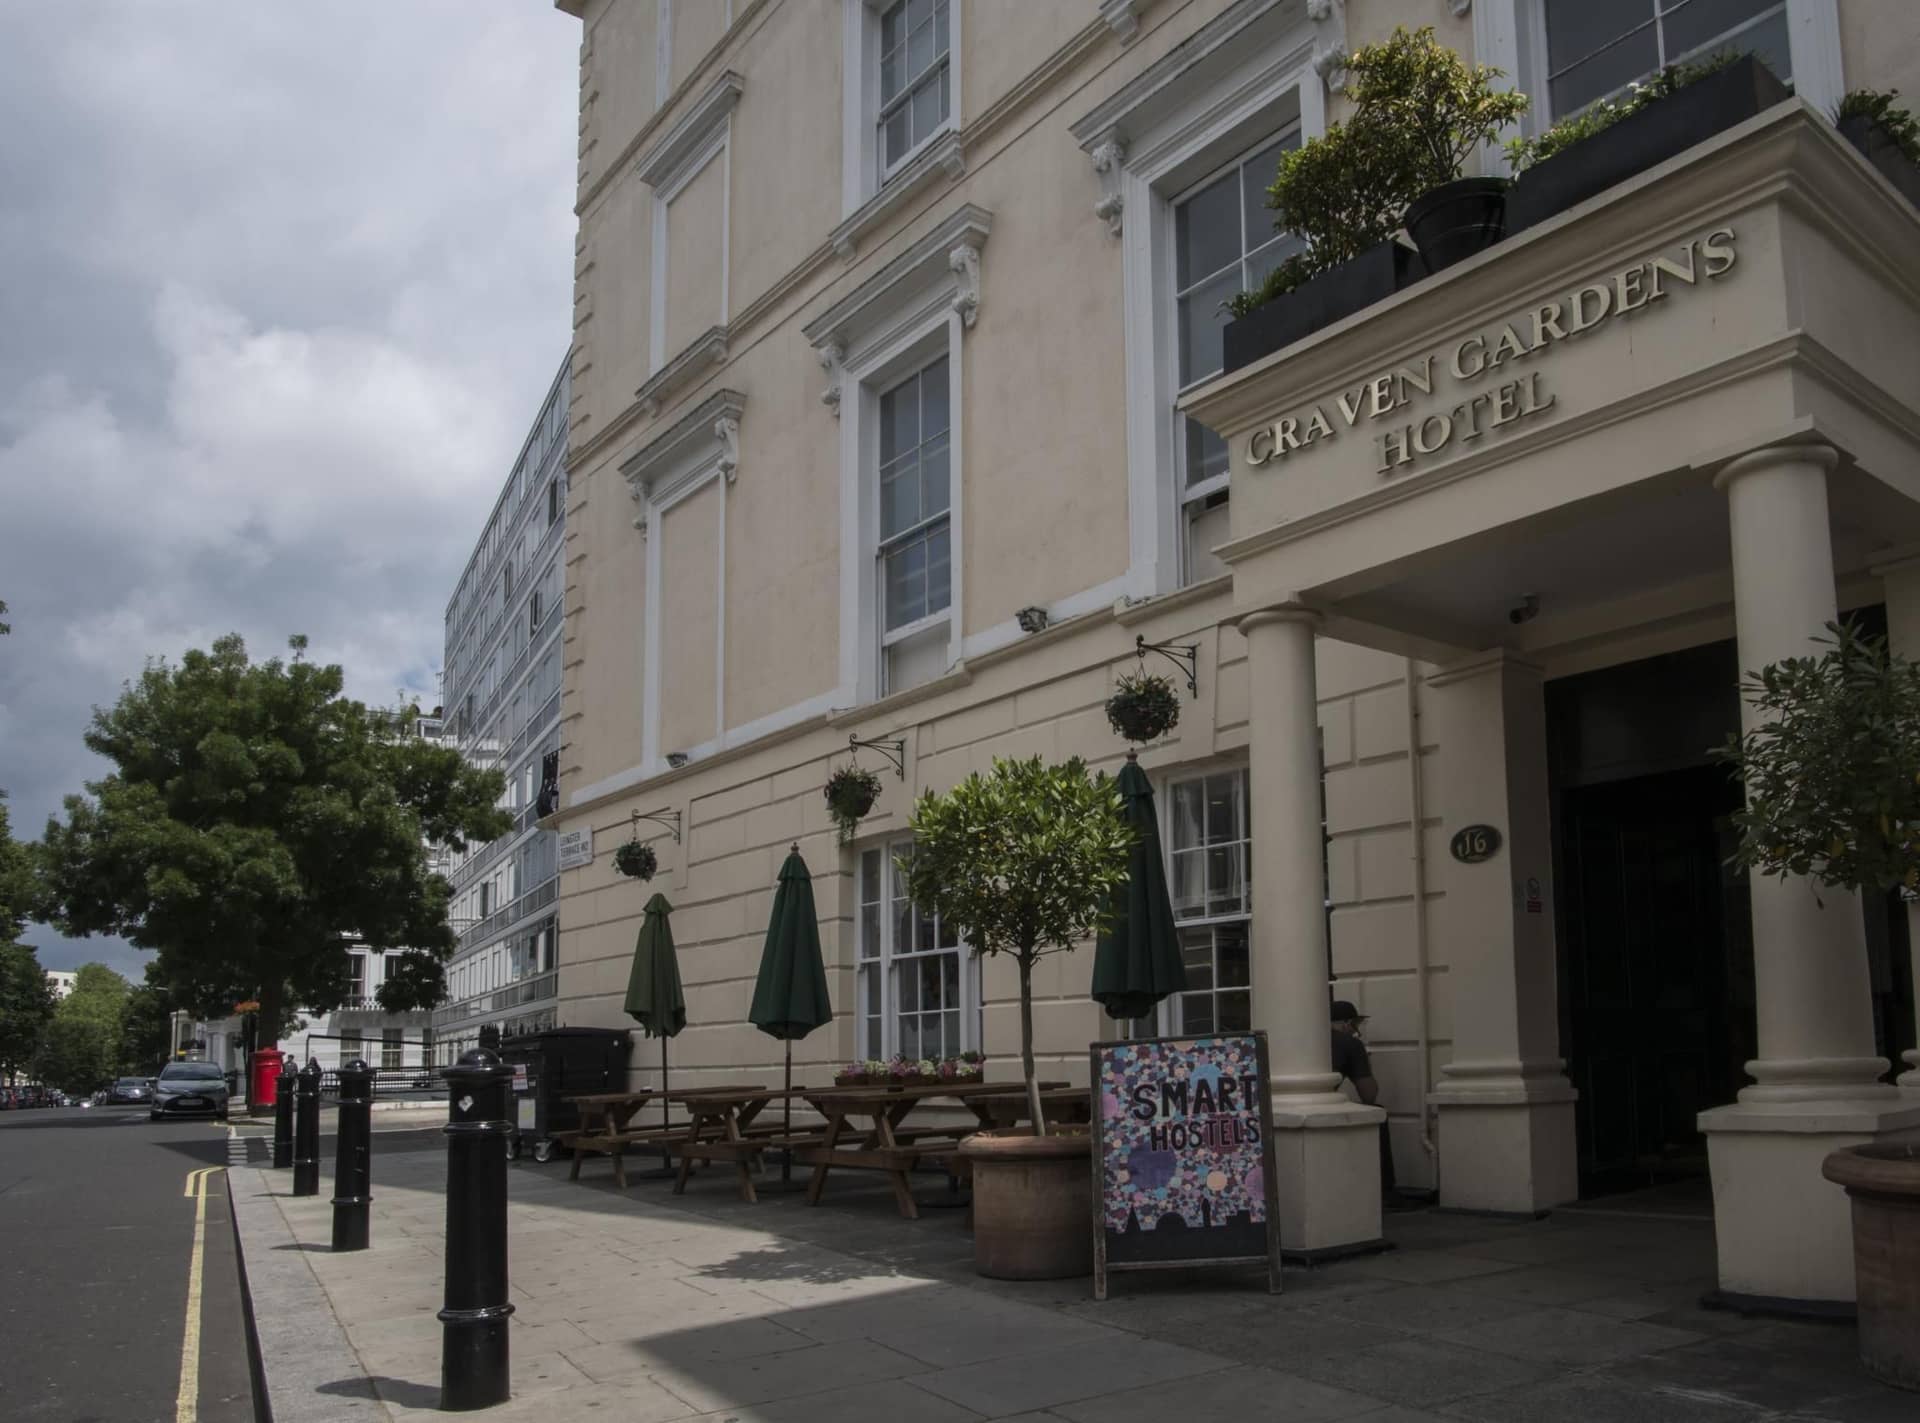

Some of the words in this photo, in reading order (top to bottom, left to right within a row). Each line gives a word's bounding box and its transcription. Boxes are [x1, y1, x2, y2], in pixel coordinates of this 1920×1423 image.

[1245, 354, 1435, 466] CRAVEN
[1449, 227, 1737, 380] GARDENS
[1374, 370, 1556, 475] HOTEL
[1133, 1075, 1257, 1120] SMART
[1150, 1117, 1260, 1151] HOSTELS
